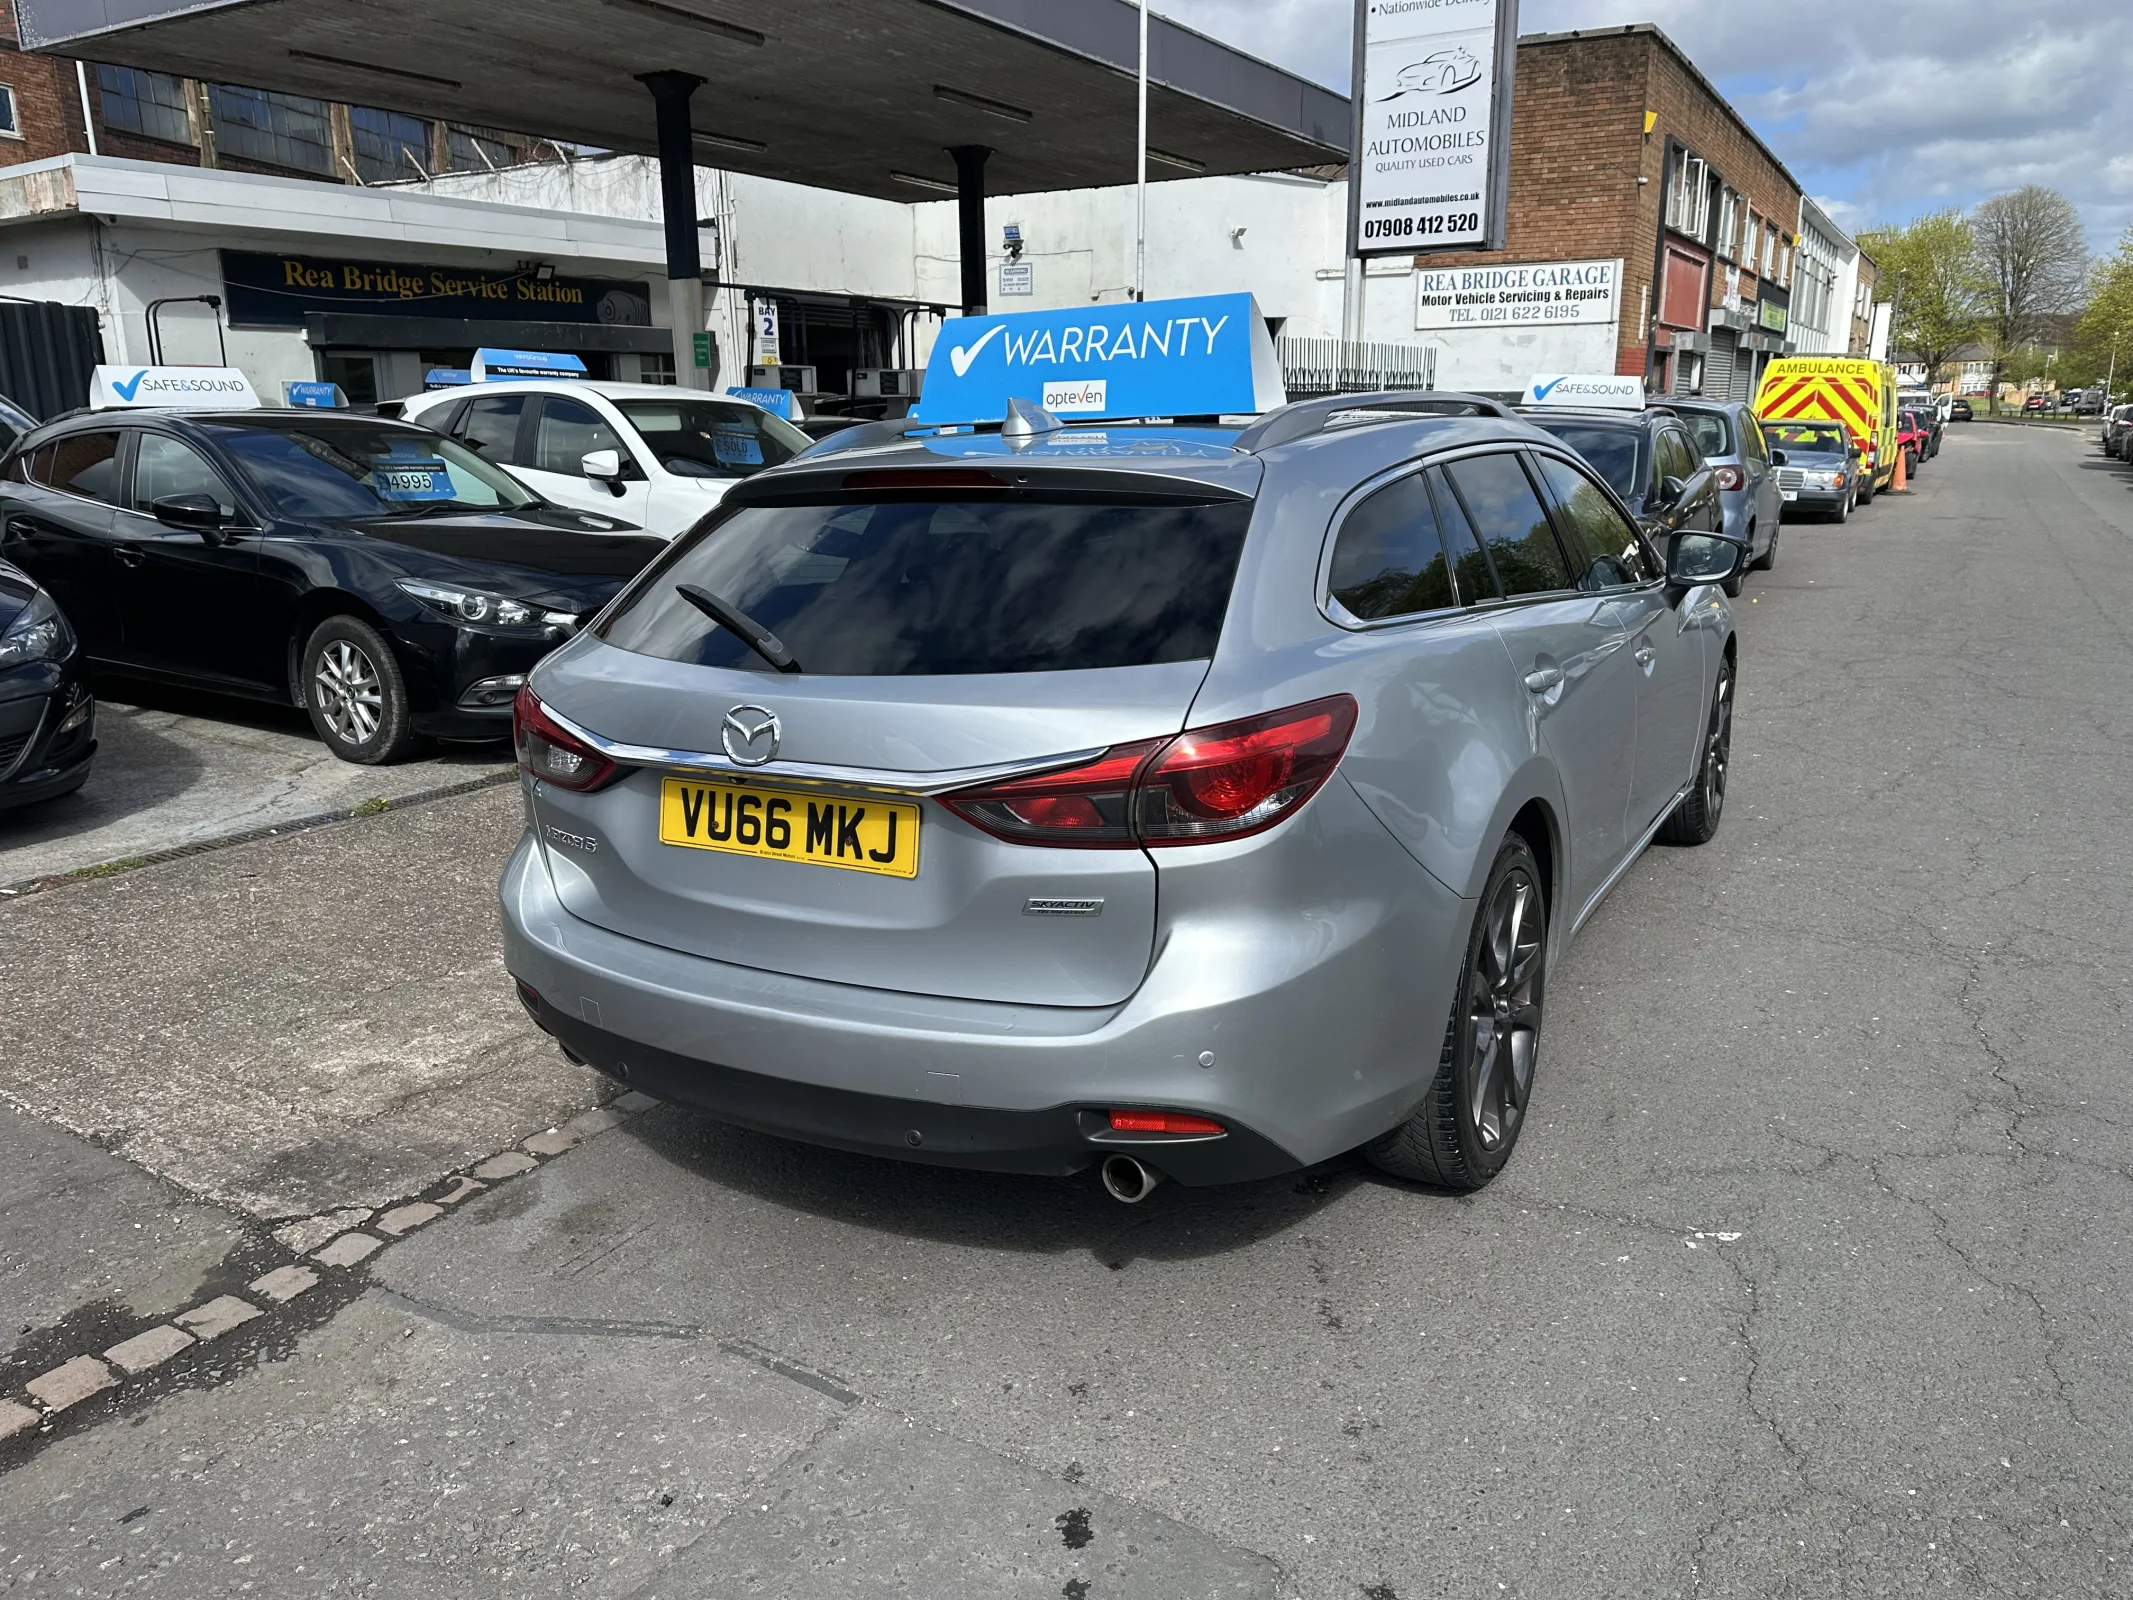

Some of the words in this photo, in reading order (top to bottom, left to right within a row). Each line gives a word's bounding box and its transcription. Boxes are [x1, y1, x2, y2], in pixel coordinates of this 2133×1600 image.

[1387, 106, 1467, 129] MIDLAND
[1366, 130, 1485, 156] AUTOMOBILES
[1375, 160, 1416, 173] QUALITY
[1419, 156, 1445, 168] USED
[1447, 154, 1473, 166] CARS
[1365, 192, 1480, 208] www.midlandautomobiles.co.uk
[1364, 217, 1413, 238] 07908
[1417, 215, 1444, 234] 412
[1447, 212, 1478, 233] 520
[283, 260, 335, 288] Rea
[344, 265, 424, 299] Bridge
[431, 271, 508, 299] Service
[517, 278, 583, 303] Station
[1423, 273, 1457, 291] REA
[1462, 269, 1529, 290] BRIDGE
[1532, 265, 1611, 286] GARAGE
[1421, 294, 1453, 306] Motor
[1455, 291, 1496, 305] Vehicle
[1499, 289, 1550, 303] Servicing
[1554, 290, 1562, 301] &
[1565, 288, 1609, 301] Repairs
[758, 307, 776, 316] BAY
[1449, 308, 1477, 322] TEL.
[1480, 307, 1508, 321] 0121
[1512, 306, 1541, 320] 622
[1544, 304, 1580, 319] 6195
[763, 317, 774, 336] 2
[1004, 315, 1229, 367] WARRANTY
[1776, 363, 1866, 375] AMBULANCE
[142, 379, 244, 392] SAFE&SOUND
[300, 386, 332, 396] WARRANTY
[1555, 383, 1634, 395] SAFE&SOUND
[740, 393, 786, 405] WARRANTY
[1046, 384, 1103, 407] opteven
[723, 438, 748, 453] SOLD
[681, 787, 792, 850] VU66
[805, 802, 898, 864] MKJ
